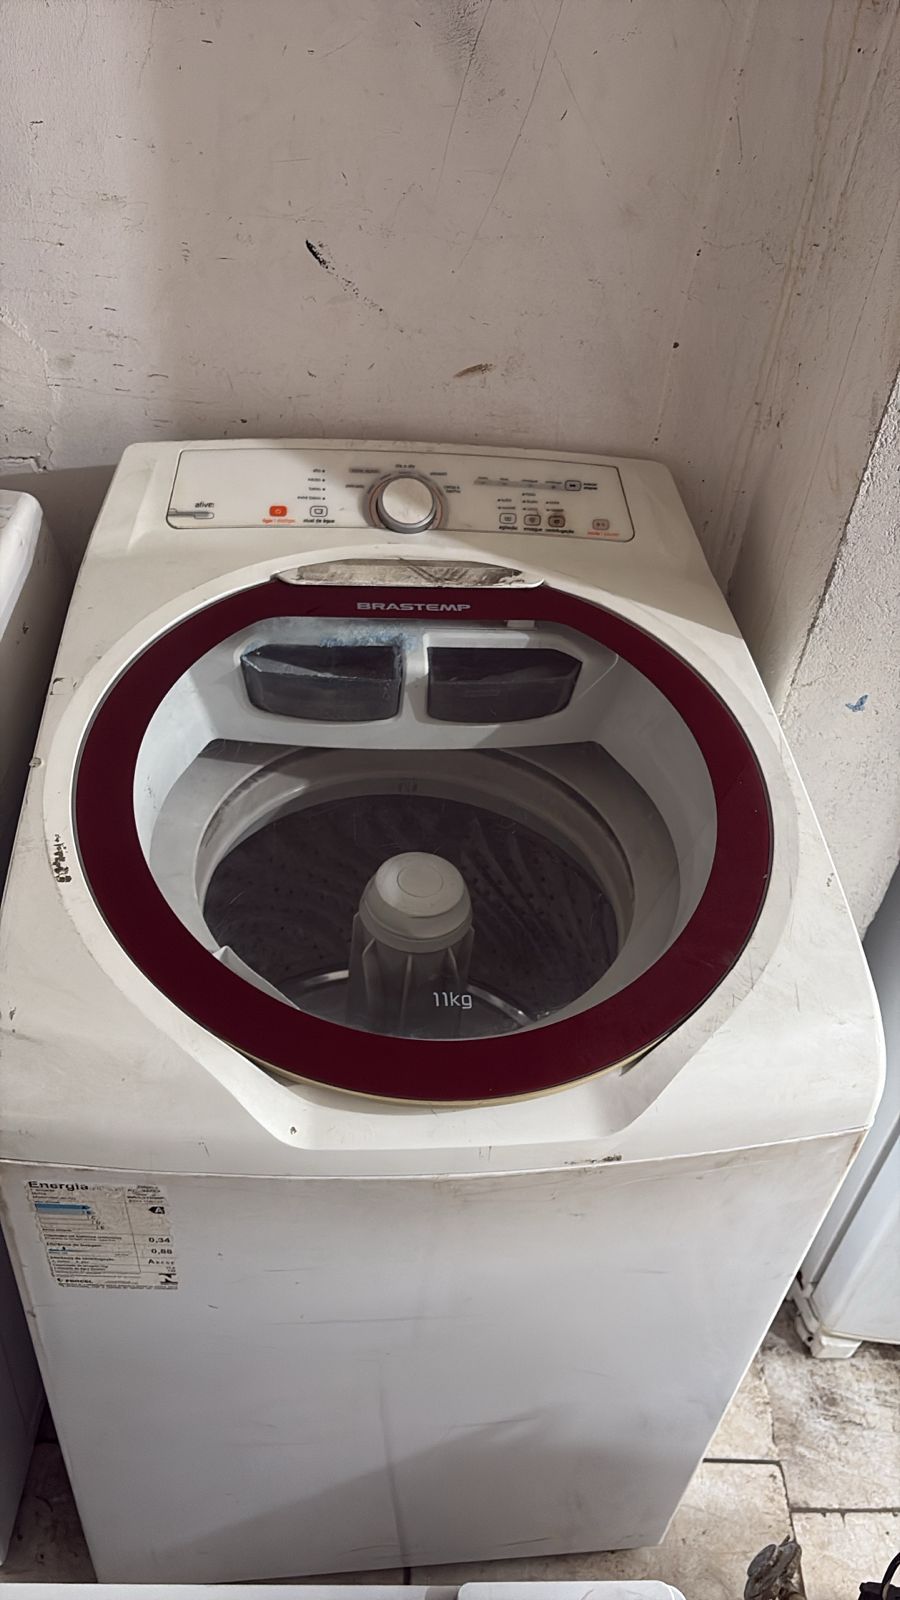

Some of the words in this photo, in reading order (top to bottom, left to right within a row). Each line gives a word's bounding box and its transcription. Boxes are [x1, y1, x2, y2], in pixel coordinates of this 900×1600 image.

[356, 602, 471, 612] BRASTEMP
[432, 991, 473, 1010] 11kg
[28, 1181, 89, 1191] Energia
